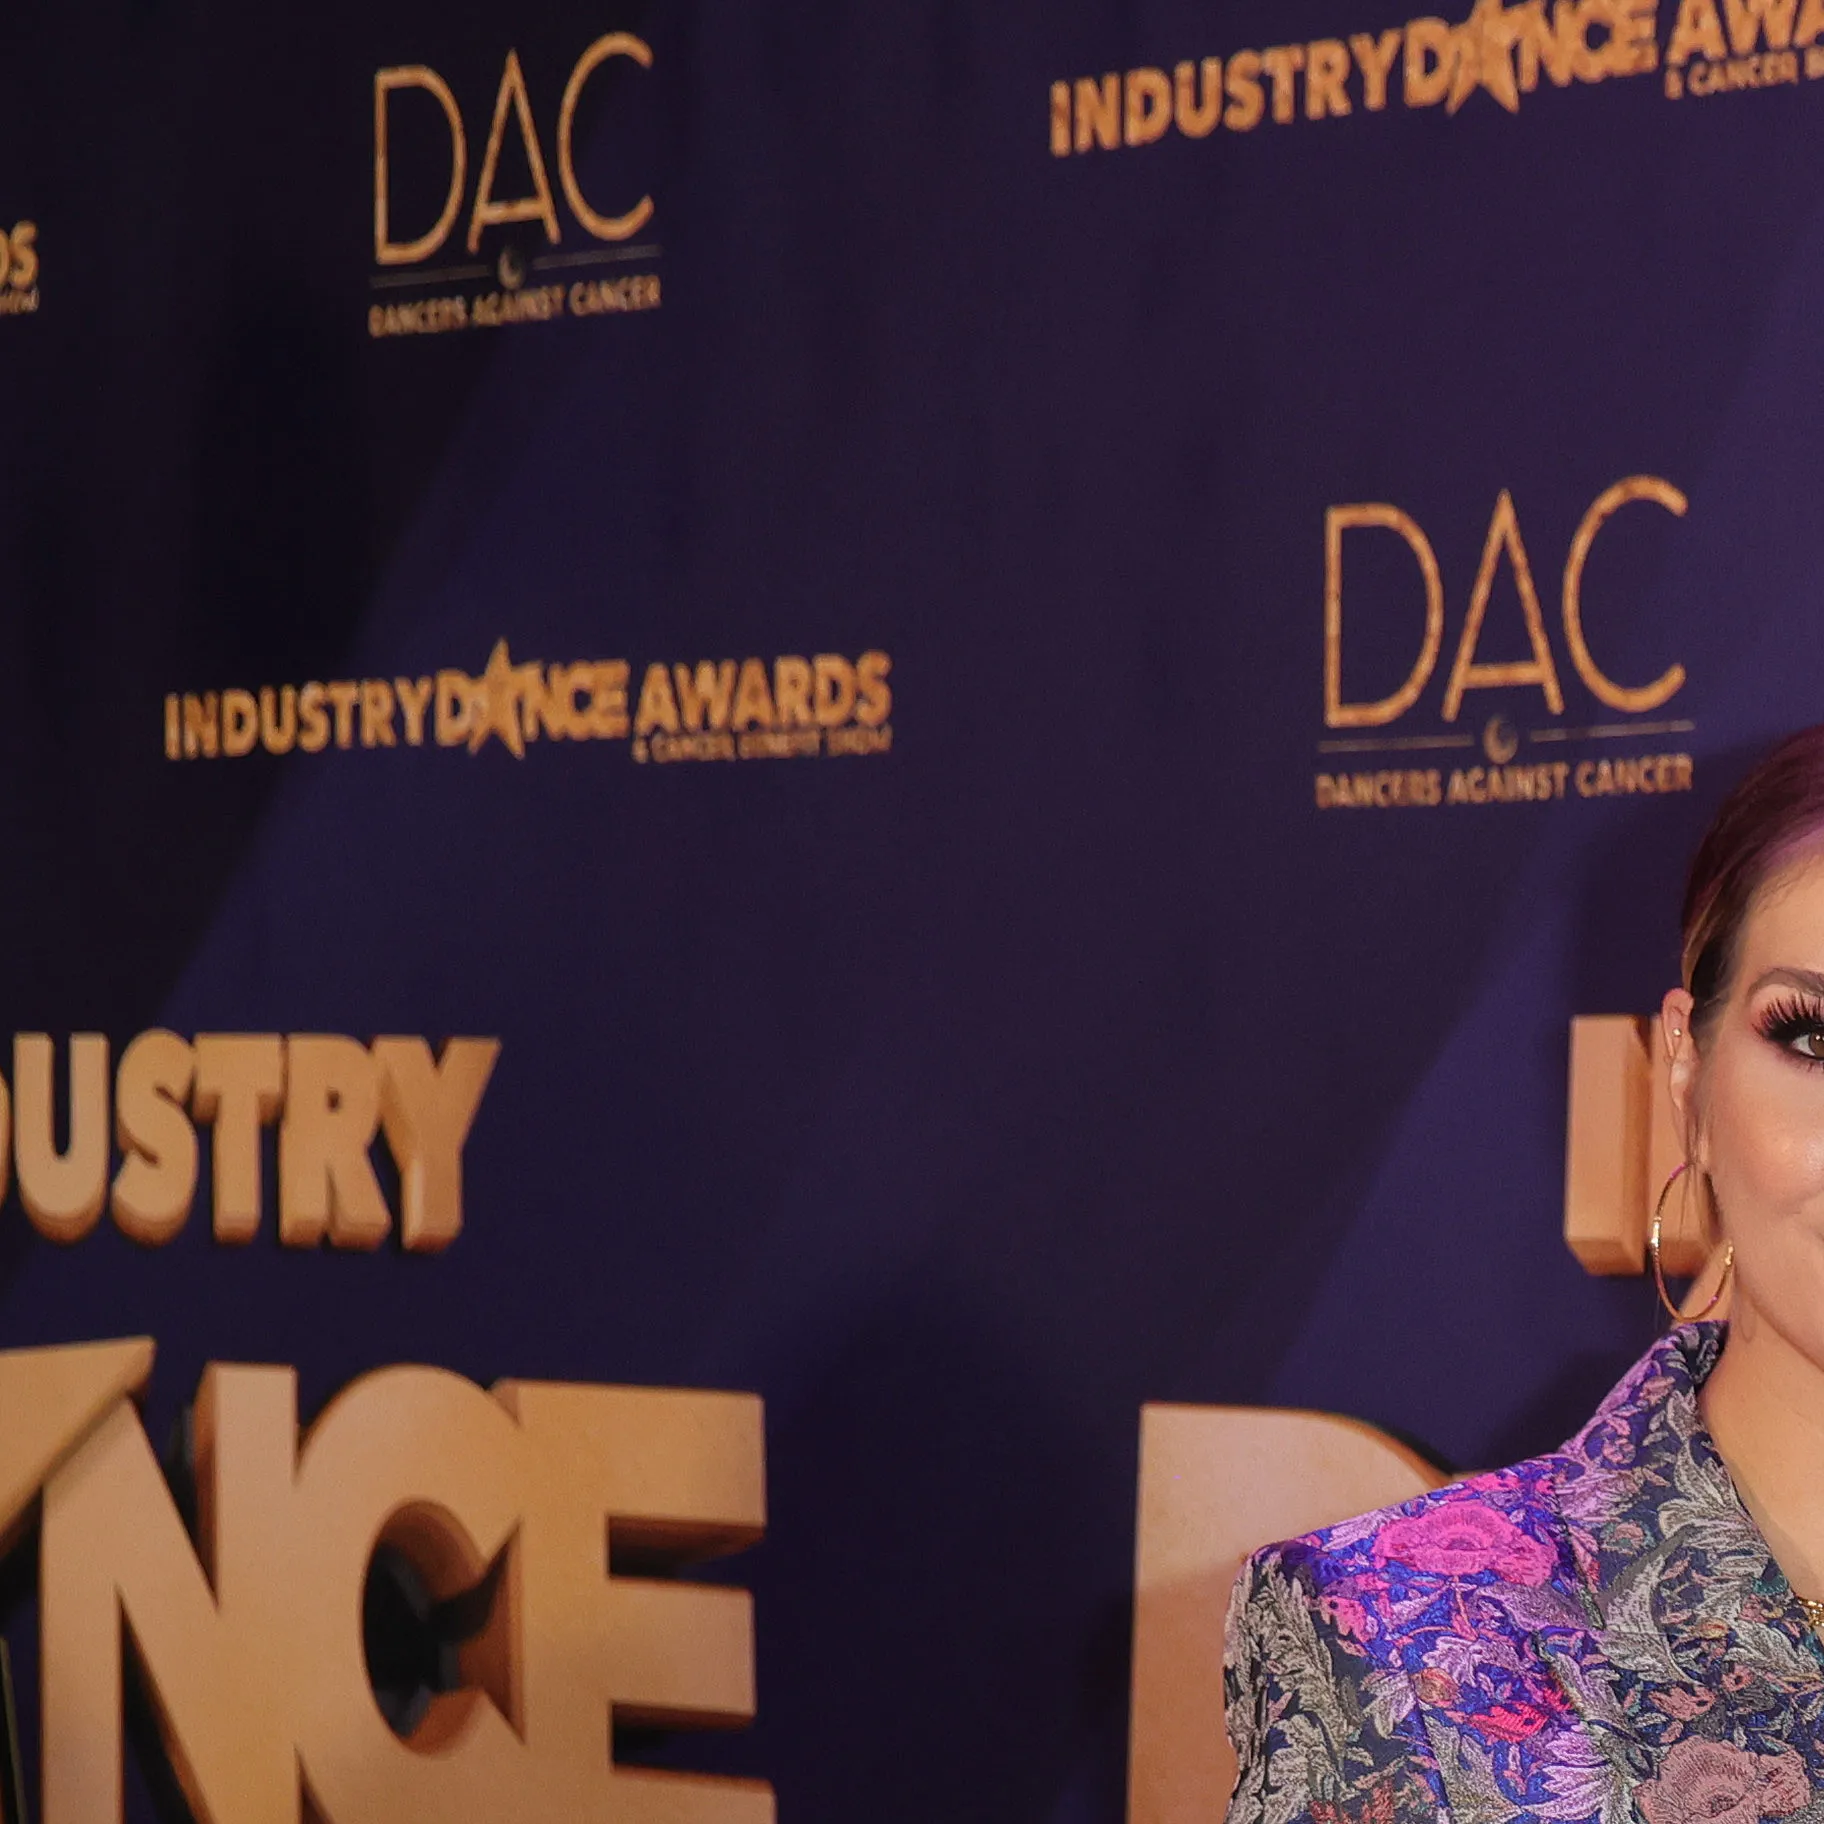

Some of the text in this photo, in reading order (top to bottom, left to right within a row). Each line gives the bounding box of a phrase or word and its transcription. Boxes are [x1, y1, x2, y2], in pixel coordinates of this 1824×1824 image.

[373, 32, 653, 264] DAC
[163, 675, 432, 762] INDUSTRY
[632, 649, 894, 738] AWARDS
[1323, 473, 1689, 728] DAC
[1315, 753, 1694, 809] DANCERS AGAINST CANCER
[0, 1028, 501, 1253] USTRY
